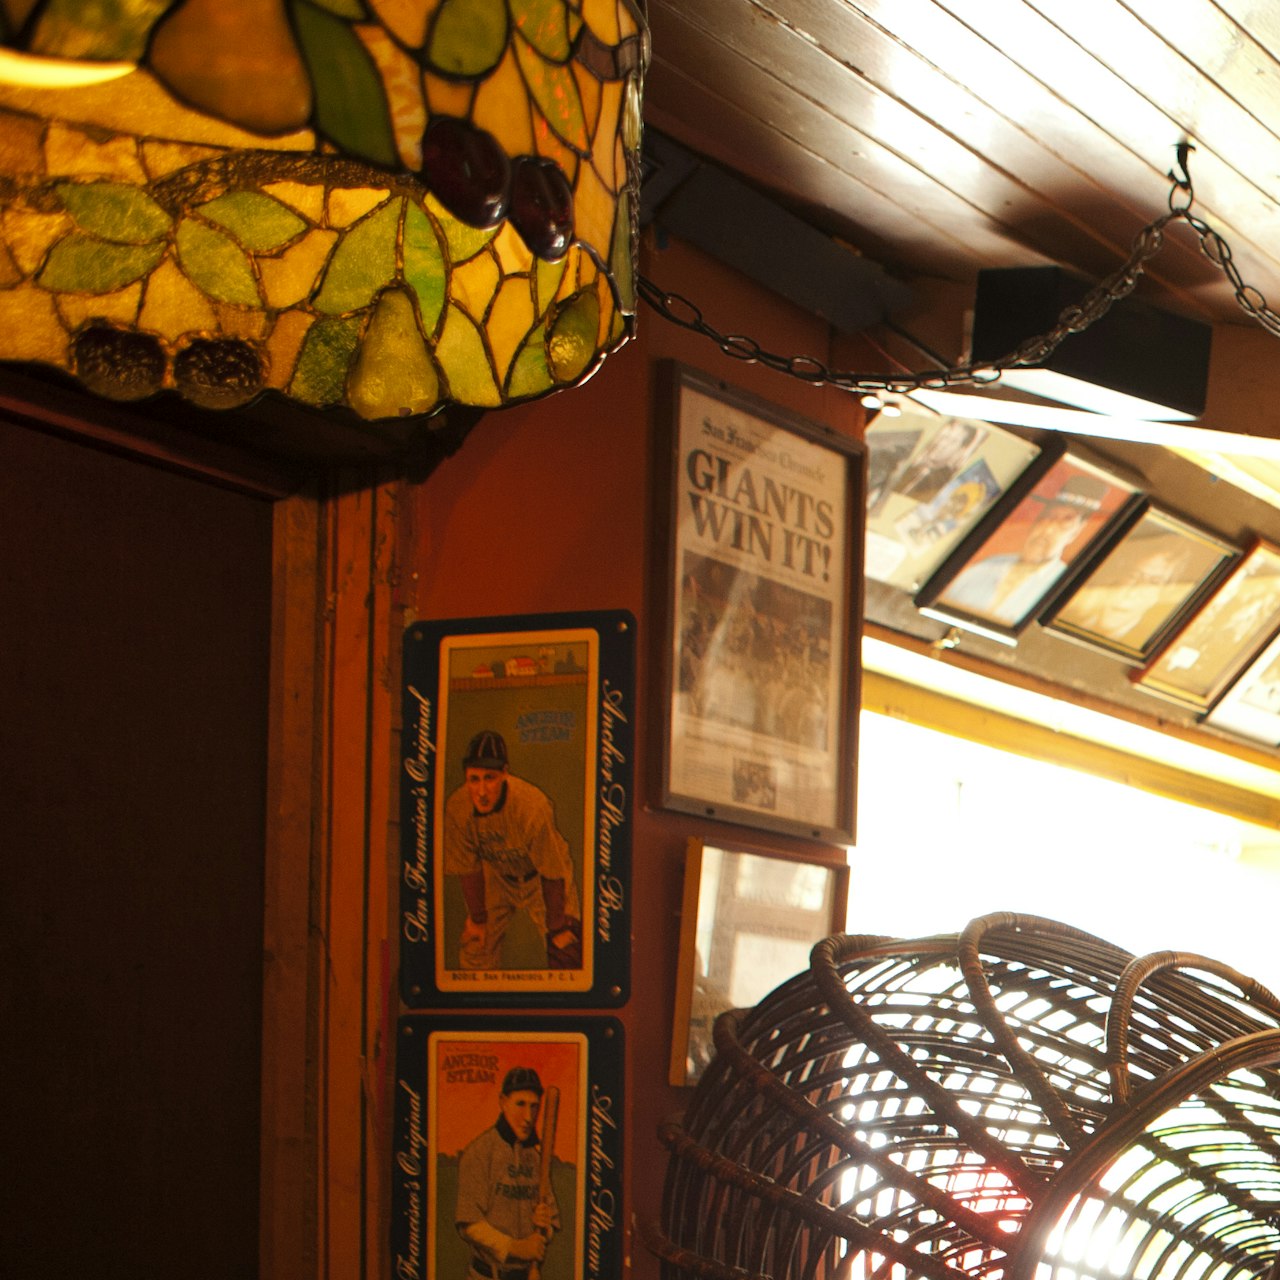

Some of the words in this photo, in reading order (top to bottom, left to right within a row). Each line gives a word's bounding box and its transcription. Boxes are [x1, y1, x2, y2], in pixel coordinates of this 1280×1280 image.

[686, 449, 835, 540] GIANTS
[687, 491, 774, 563] WIN
[783, 527, 833, 583] IT!
[405, 685, 436, 782] Original
[600, 678, 628, 783] Anchor
[404, 782, 430, 892] Francisco's
[599, 783, 627, 870] Steam
[404, 895, 430, 942] San
[598, 874, 625, 942] Beer
[441, 1053, 500, 1072] ANCHOR
[446, 1069, 497, 1085] STEAM
[397, 1080, 428, 1178] Original
[590, 1084, 618, 1188] Anchor
[589, 1188, 617, 1277] Steam
